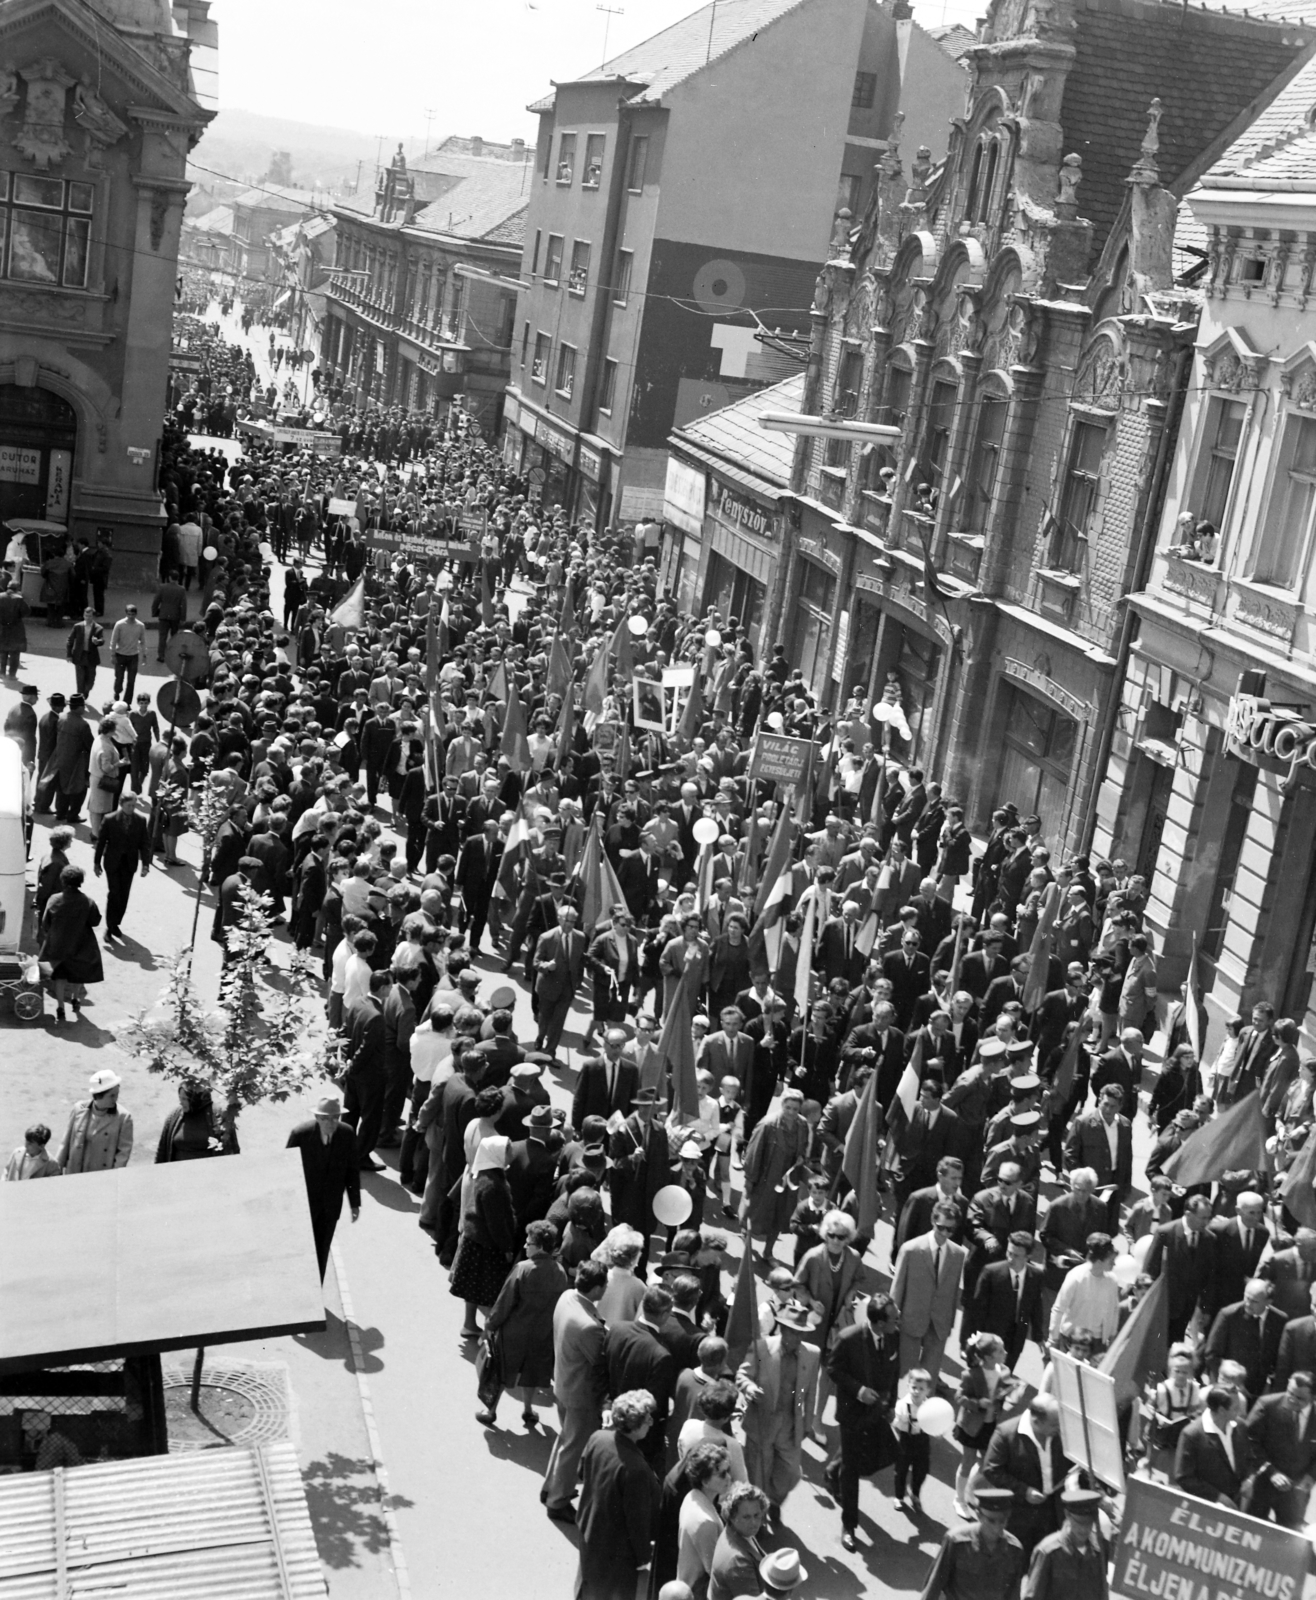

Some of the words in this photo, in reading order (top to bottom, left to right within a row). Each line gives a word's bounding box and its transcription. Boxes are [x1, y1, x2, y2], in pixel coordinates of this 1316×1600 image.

[1170, 1501, 1263, 1550] ÉLJEN
[1124, 1522, 1139, 1547] A
[1140, 1526, 1296, 1600] KOMMUNIZMUS
[1124, 1551, 1195, 1600] ÉLJEN
